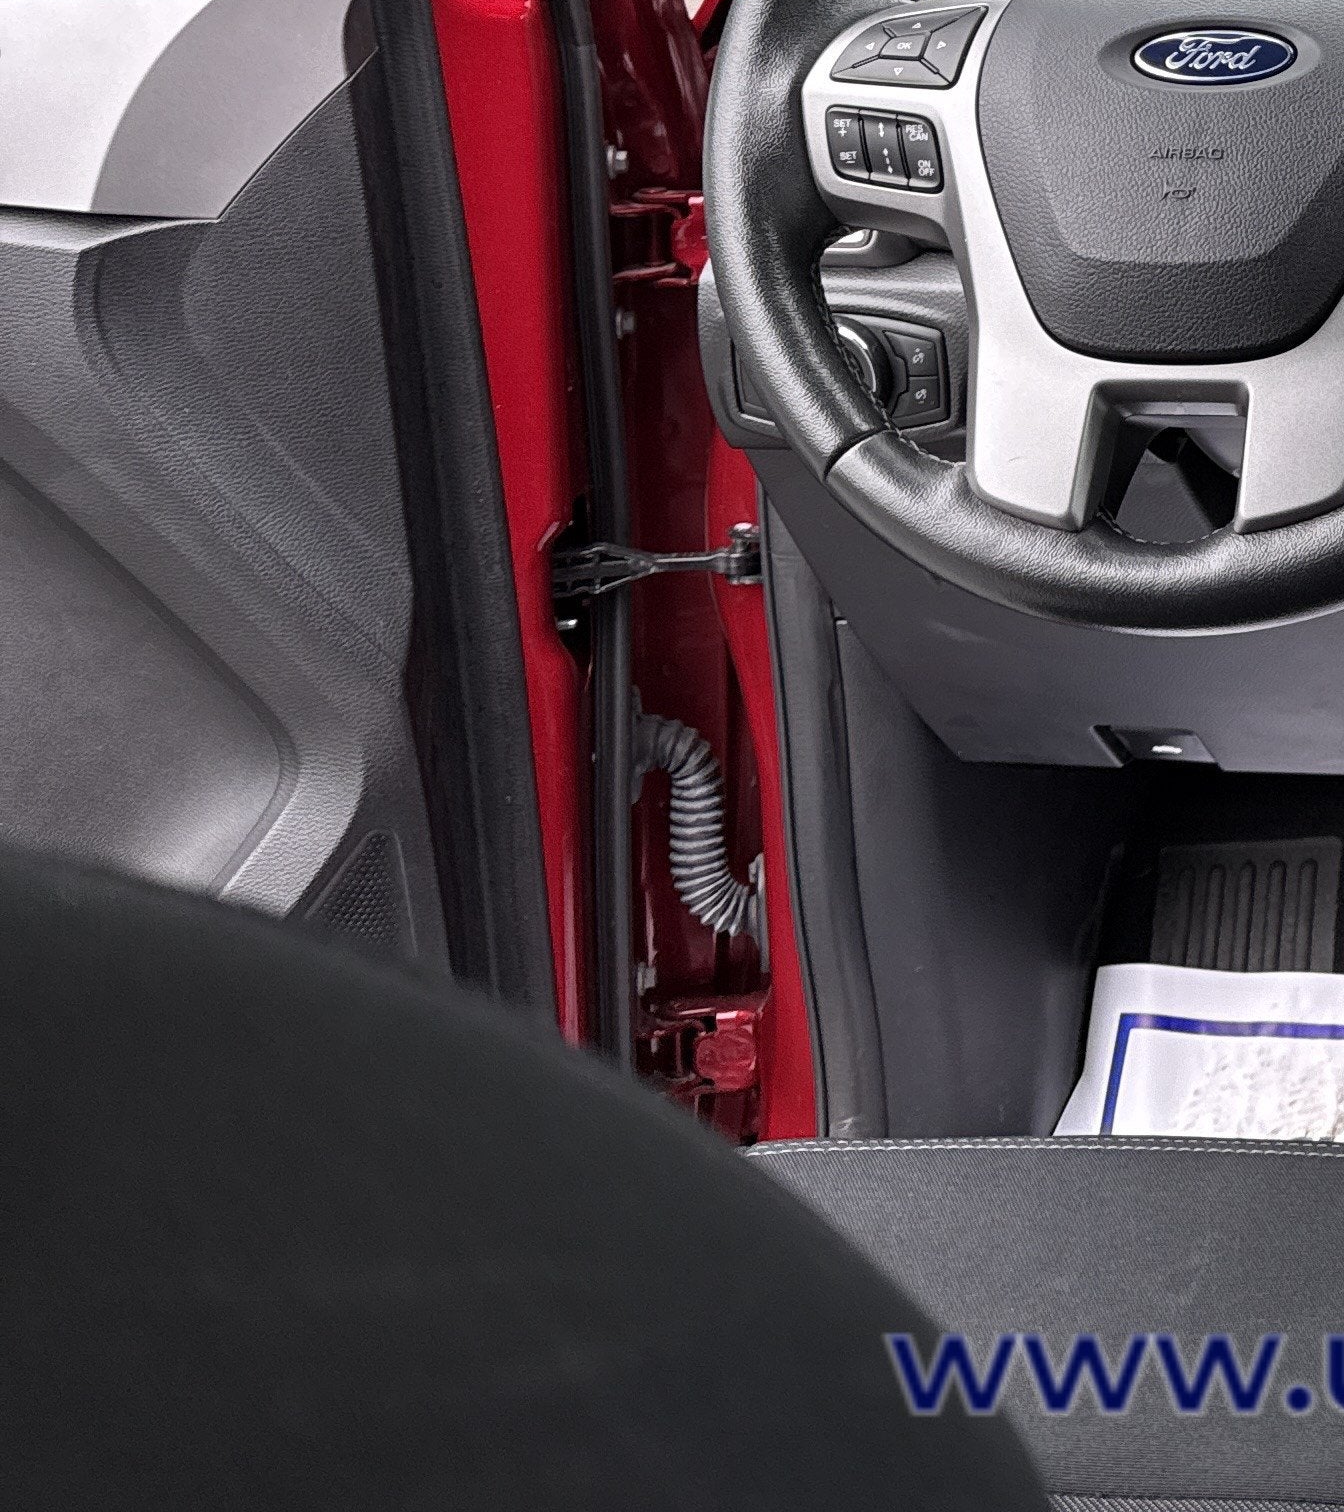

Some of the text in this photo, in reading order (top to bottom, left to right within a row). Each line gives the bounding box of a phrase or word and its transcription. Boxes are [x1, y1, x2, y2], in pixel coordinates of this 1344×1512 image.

[897, 41, 913, 50] OK
[833, 119, 924, 134] SET RES
[909, 132, 929, 142] CAN
[839, 151, 931, 169] SET ON
[1148, 147, 1224, 161] AIRBAG
[918, 168, 935, 177] OFF
